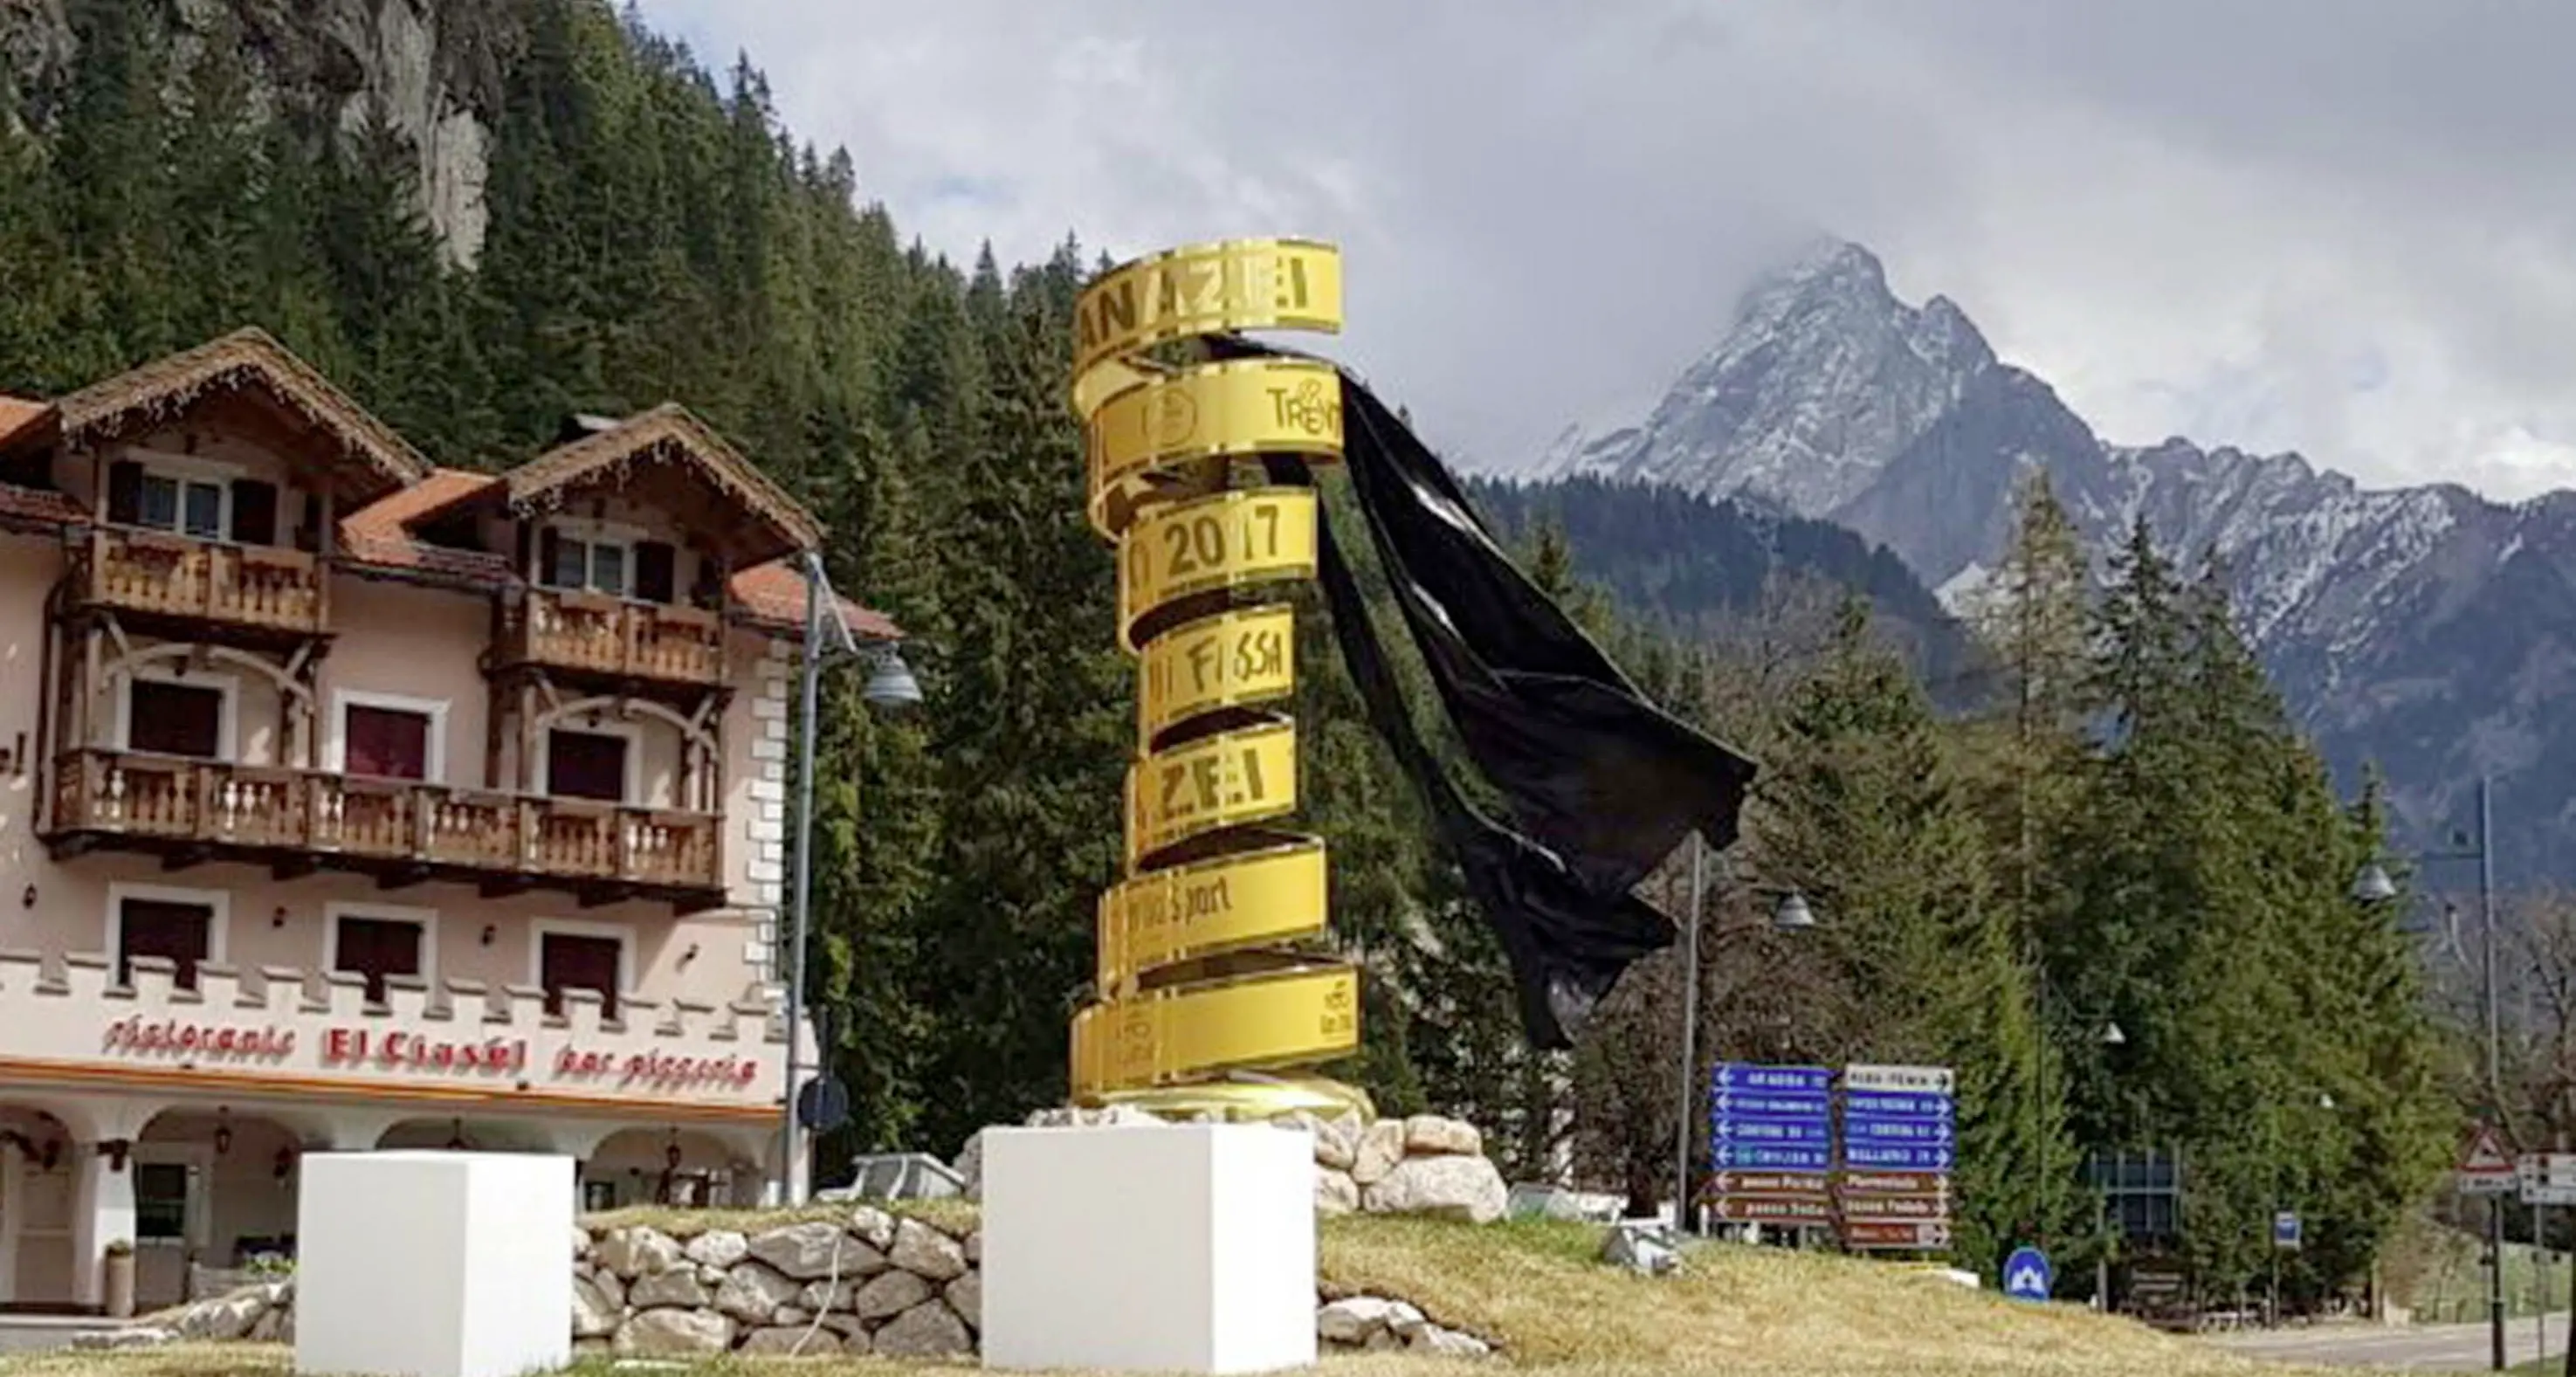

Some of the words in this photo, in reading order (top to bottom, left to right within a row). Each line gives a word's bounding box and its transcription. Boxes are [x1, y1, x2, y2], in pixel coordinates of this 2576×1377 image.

[1164, 504, 1279, 576] 2017
[321, 1028, 370, 1069] El
[554, 1043, 616, 1080] bar
